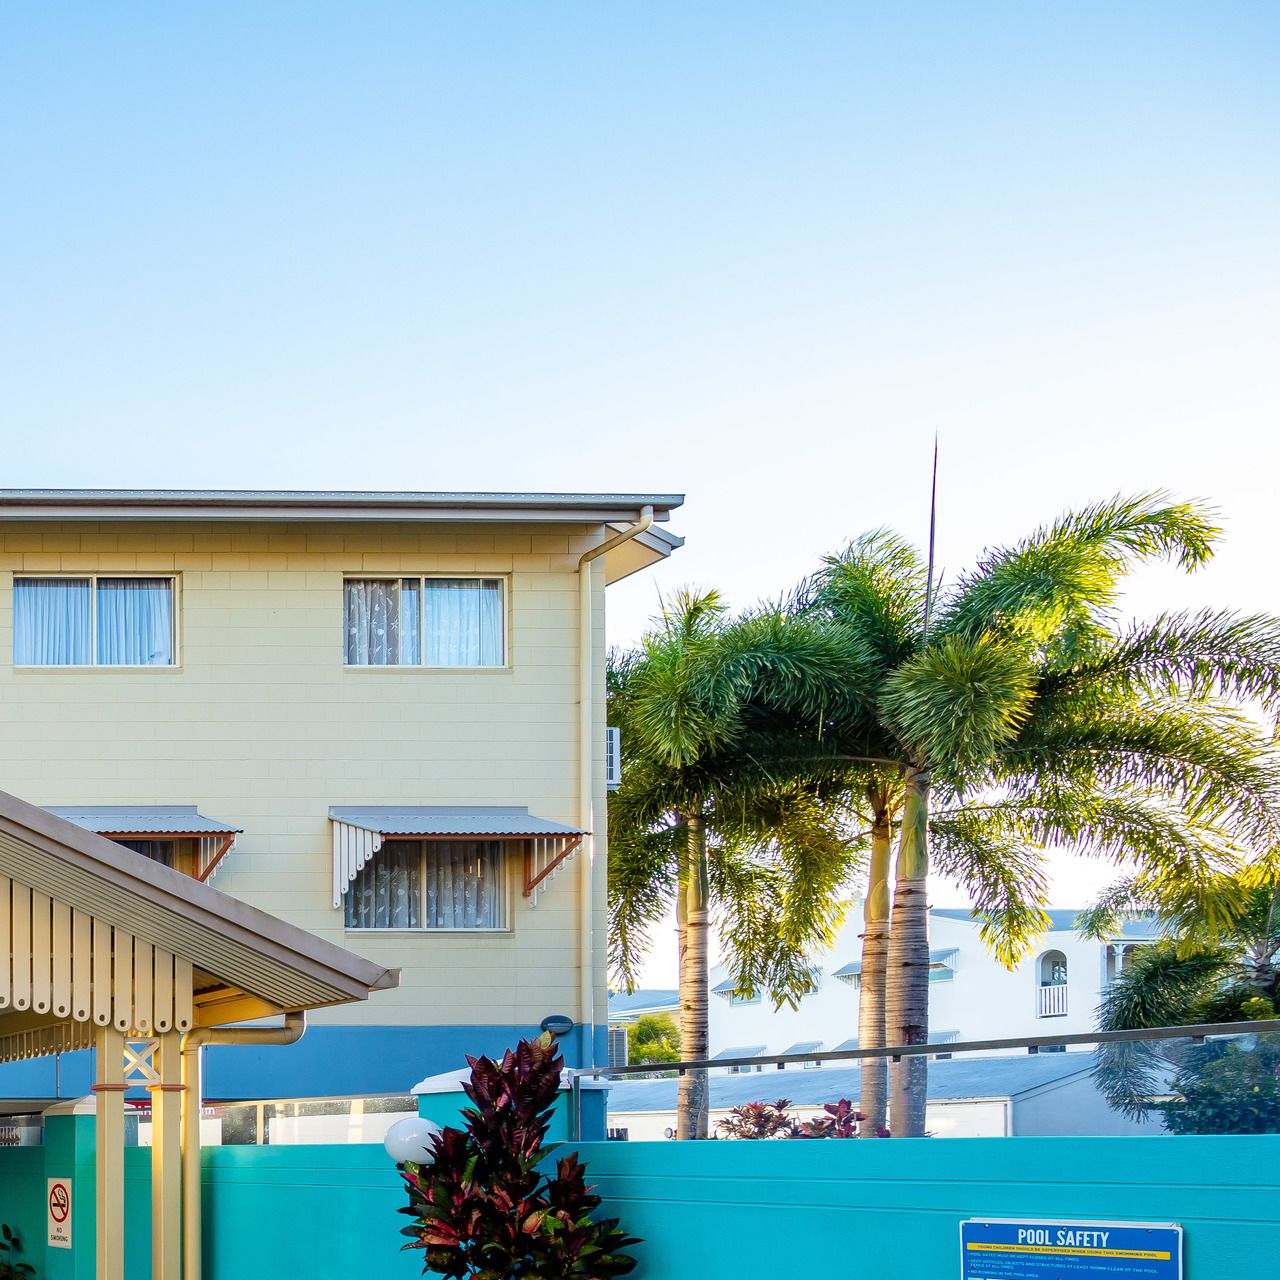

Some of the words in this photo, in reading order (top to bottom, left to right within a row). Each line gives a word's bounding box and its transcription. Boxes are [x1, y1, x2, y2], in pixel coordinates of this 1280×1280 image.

[50, 1234, 68, 1242] SMOKING
[1018, 1228, 1052, 1245] POOL
[1056, 1230, 1109, 1248] SAFETY
